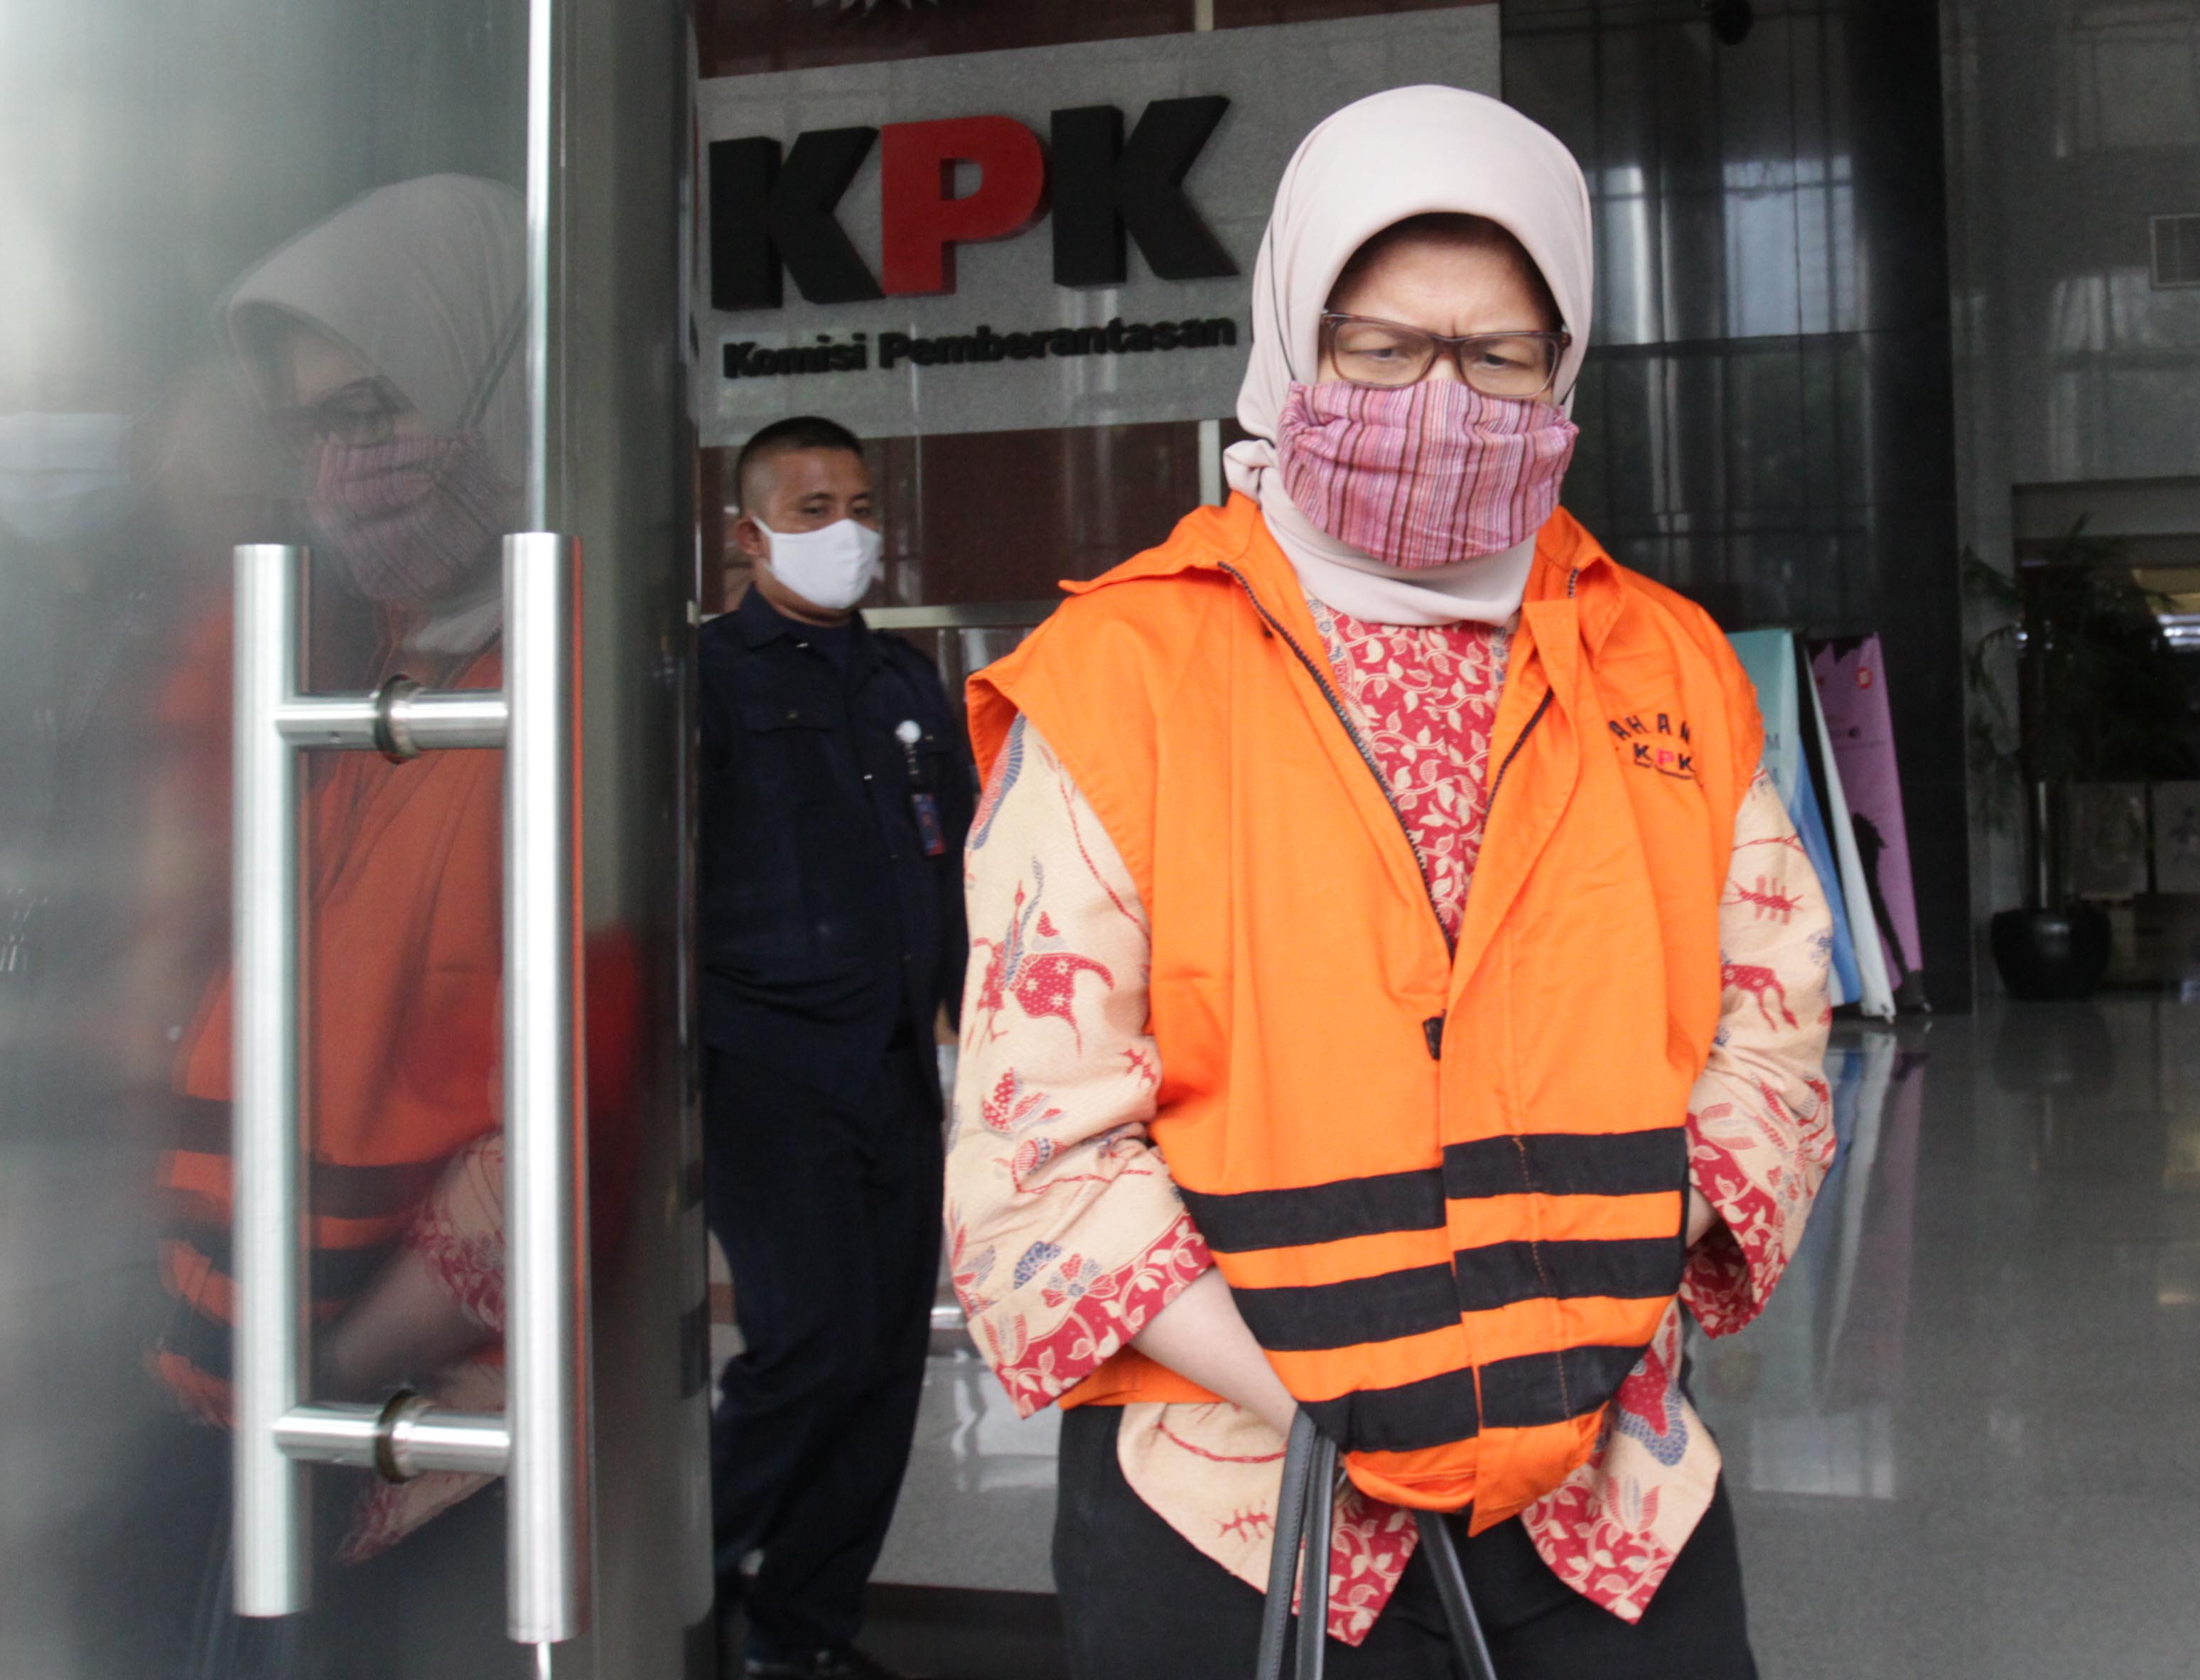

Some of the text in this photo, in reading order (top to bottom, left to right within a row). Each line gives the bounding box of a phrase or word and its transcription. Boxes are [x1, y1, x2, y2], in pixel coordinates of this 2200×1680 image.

[711, 95, 1240, 311] KPK
[723, 316, 1236, 379] Komisi Pemberantasan
[1634, 743, 1697, 772] KPK
